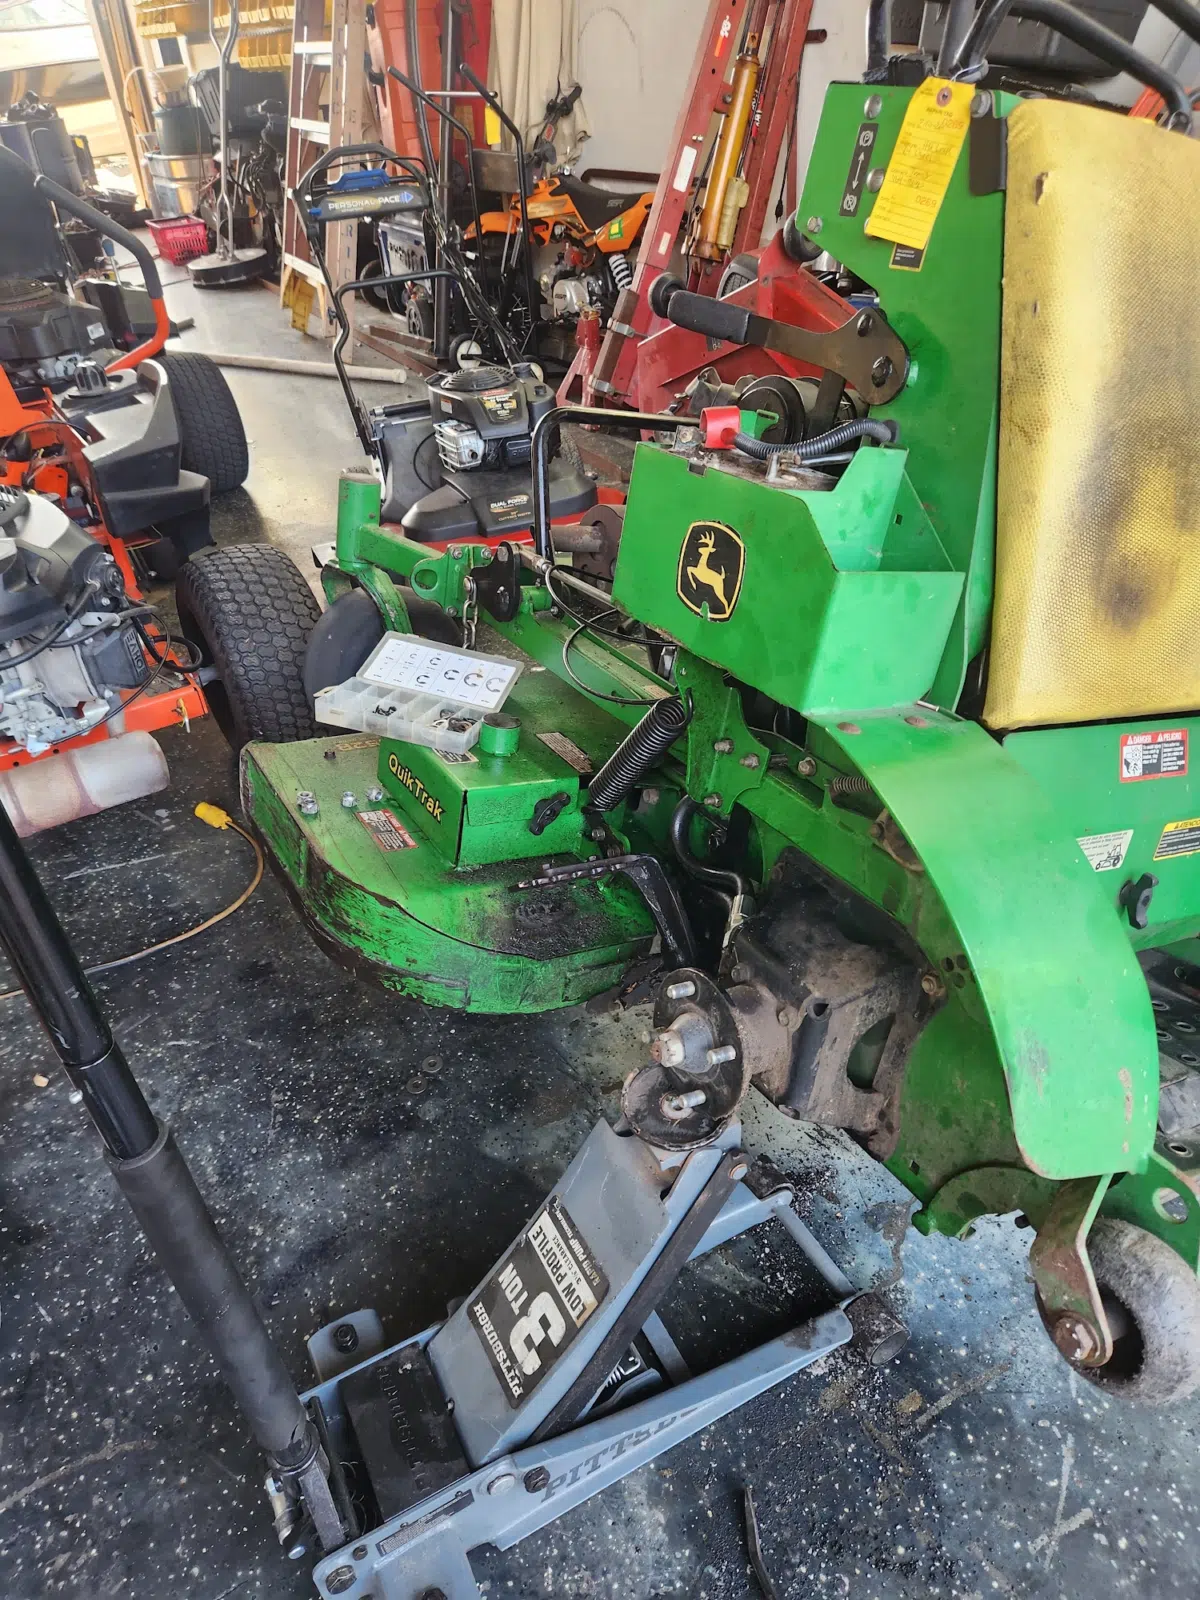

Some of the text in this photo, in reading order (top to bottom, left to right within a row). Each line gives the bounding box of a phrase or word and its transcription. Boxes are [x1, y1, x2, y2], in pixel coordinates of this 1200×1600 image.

[328, 198, 376, 211] PERSONAL
[377, 194, 401, 205] PACE
[490, 500, 507, 509] DUAL
[1132, 731, 1182, 744] DANGER PELIGRO
[387, 752, 444, 822] QuikTrak
[552, 1234, 574, 1271] CLEARANCE
[569, 1238, 587, 1262] PUMP
[532, 1224, 588, 1321] LOW PROFILE
[582, 1260, 601, 1287] RAPID
[497, 1262, 566, 1376] 3 TON
[473, 1301, 524, 1400] PITTSBURGH
